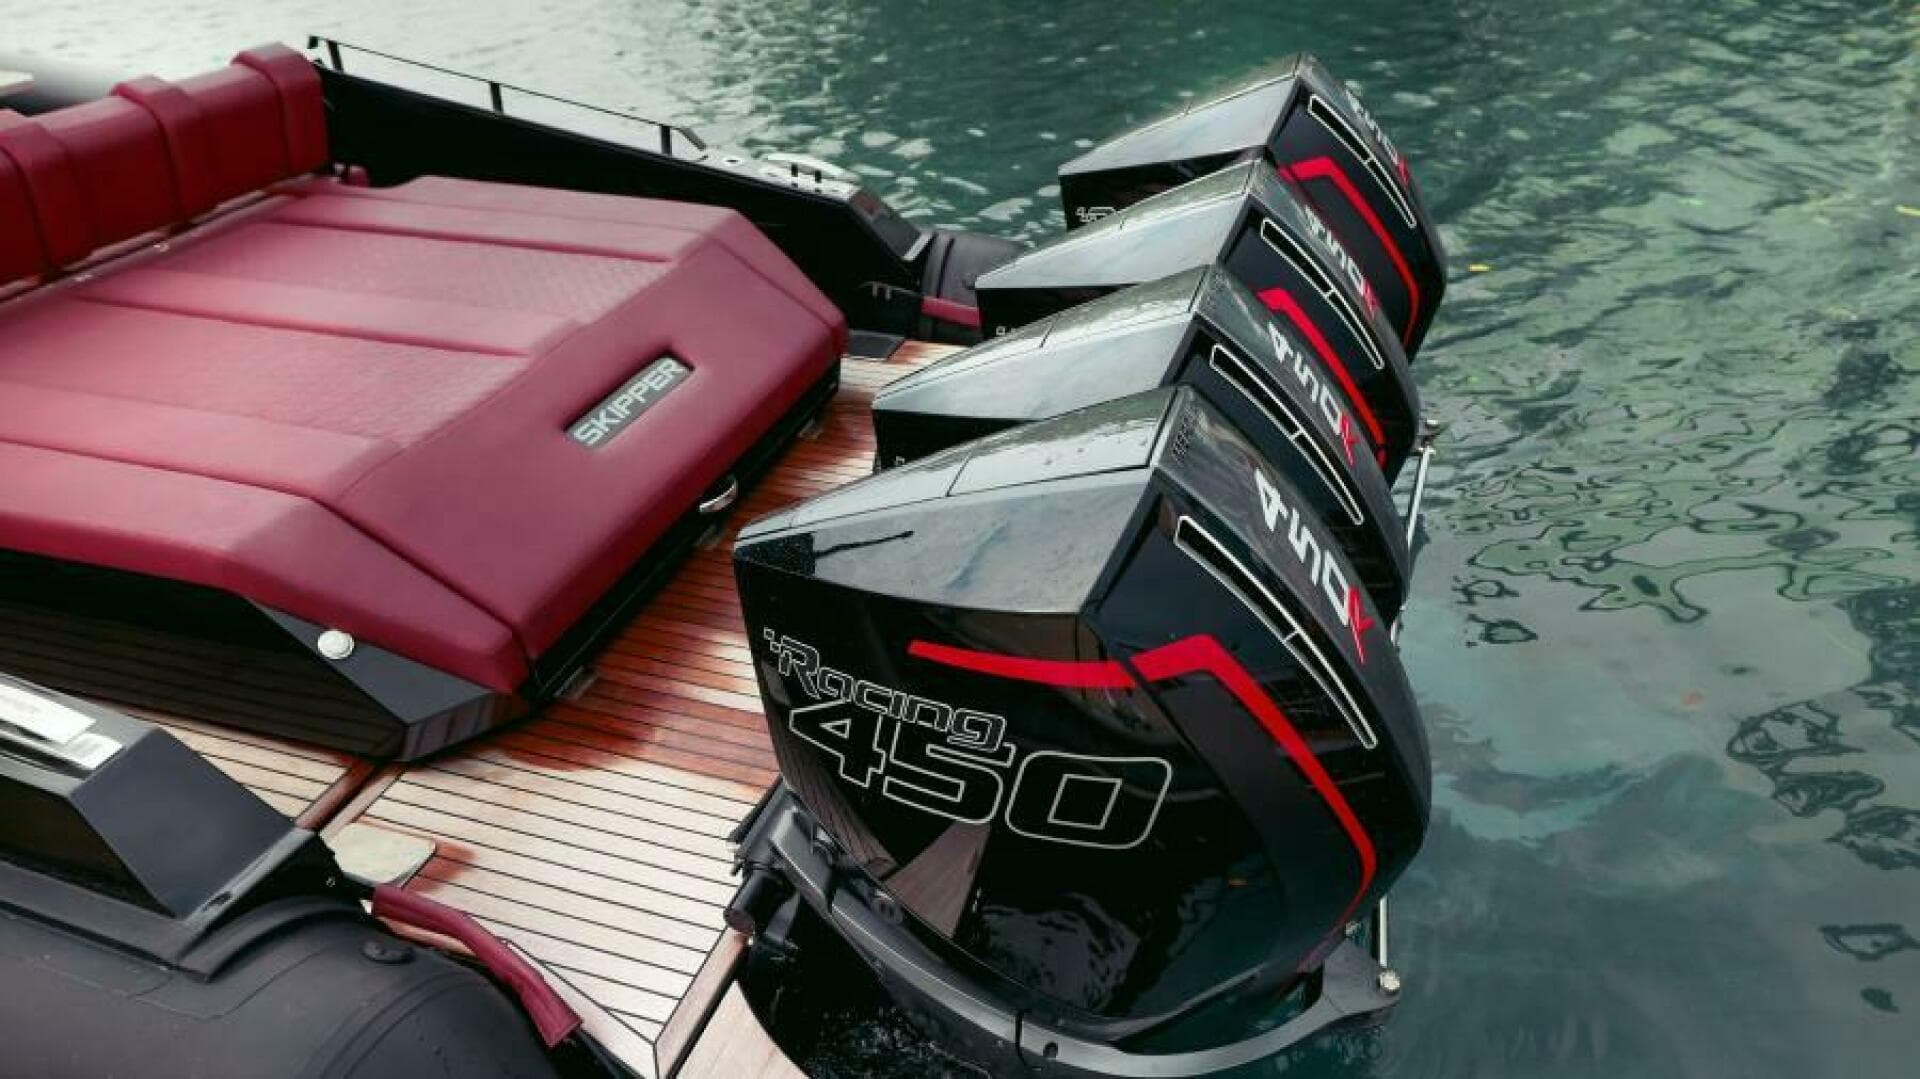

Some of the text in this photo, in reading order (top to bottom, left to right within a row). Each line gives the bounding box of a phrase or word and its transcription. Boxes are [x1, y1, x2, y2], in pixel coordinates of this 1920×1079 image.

[573, 357, 686, 445] SKIPPER
[765, 628, 1007, 752] Racing
[789, 698, 1173, 850] 450
